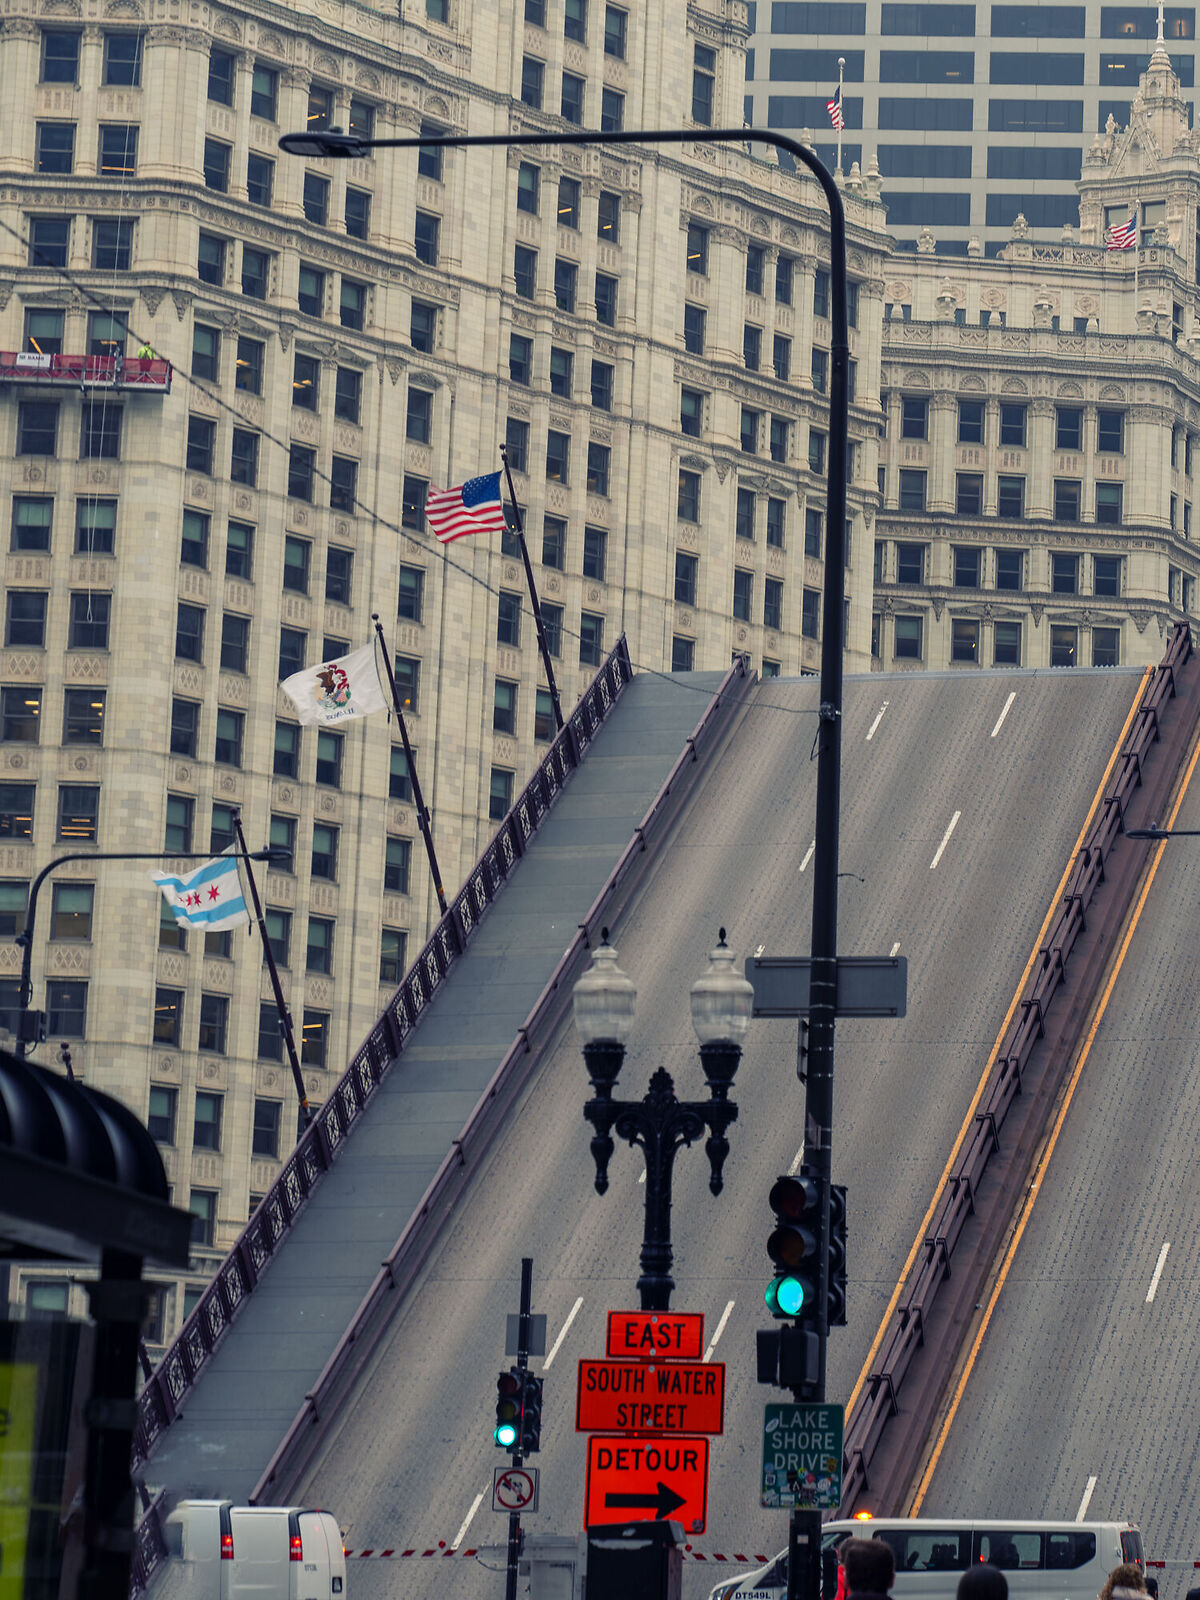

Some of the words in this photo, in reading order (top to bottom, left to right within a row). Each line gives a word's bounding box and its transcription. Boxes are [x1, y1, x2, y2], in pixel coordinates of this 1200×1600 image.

[625, 1322, 686, 1349] EAST
[586, 1367, 645, 1393] SOUTH
[657, 1370, 716, 1396] WATER
[616, 1403, 688, 1429] STREET
[779, 1411, 829, 1429] LAKE
[771, 1431, 835, 1450] SHORE
[597, 1448, 698, 1472] DETOUR
[774, 1452, 831, 1471] DRIVE
